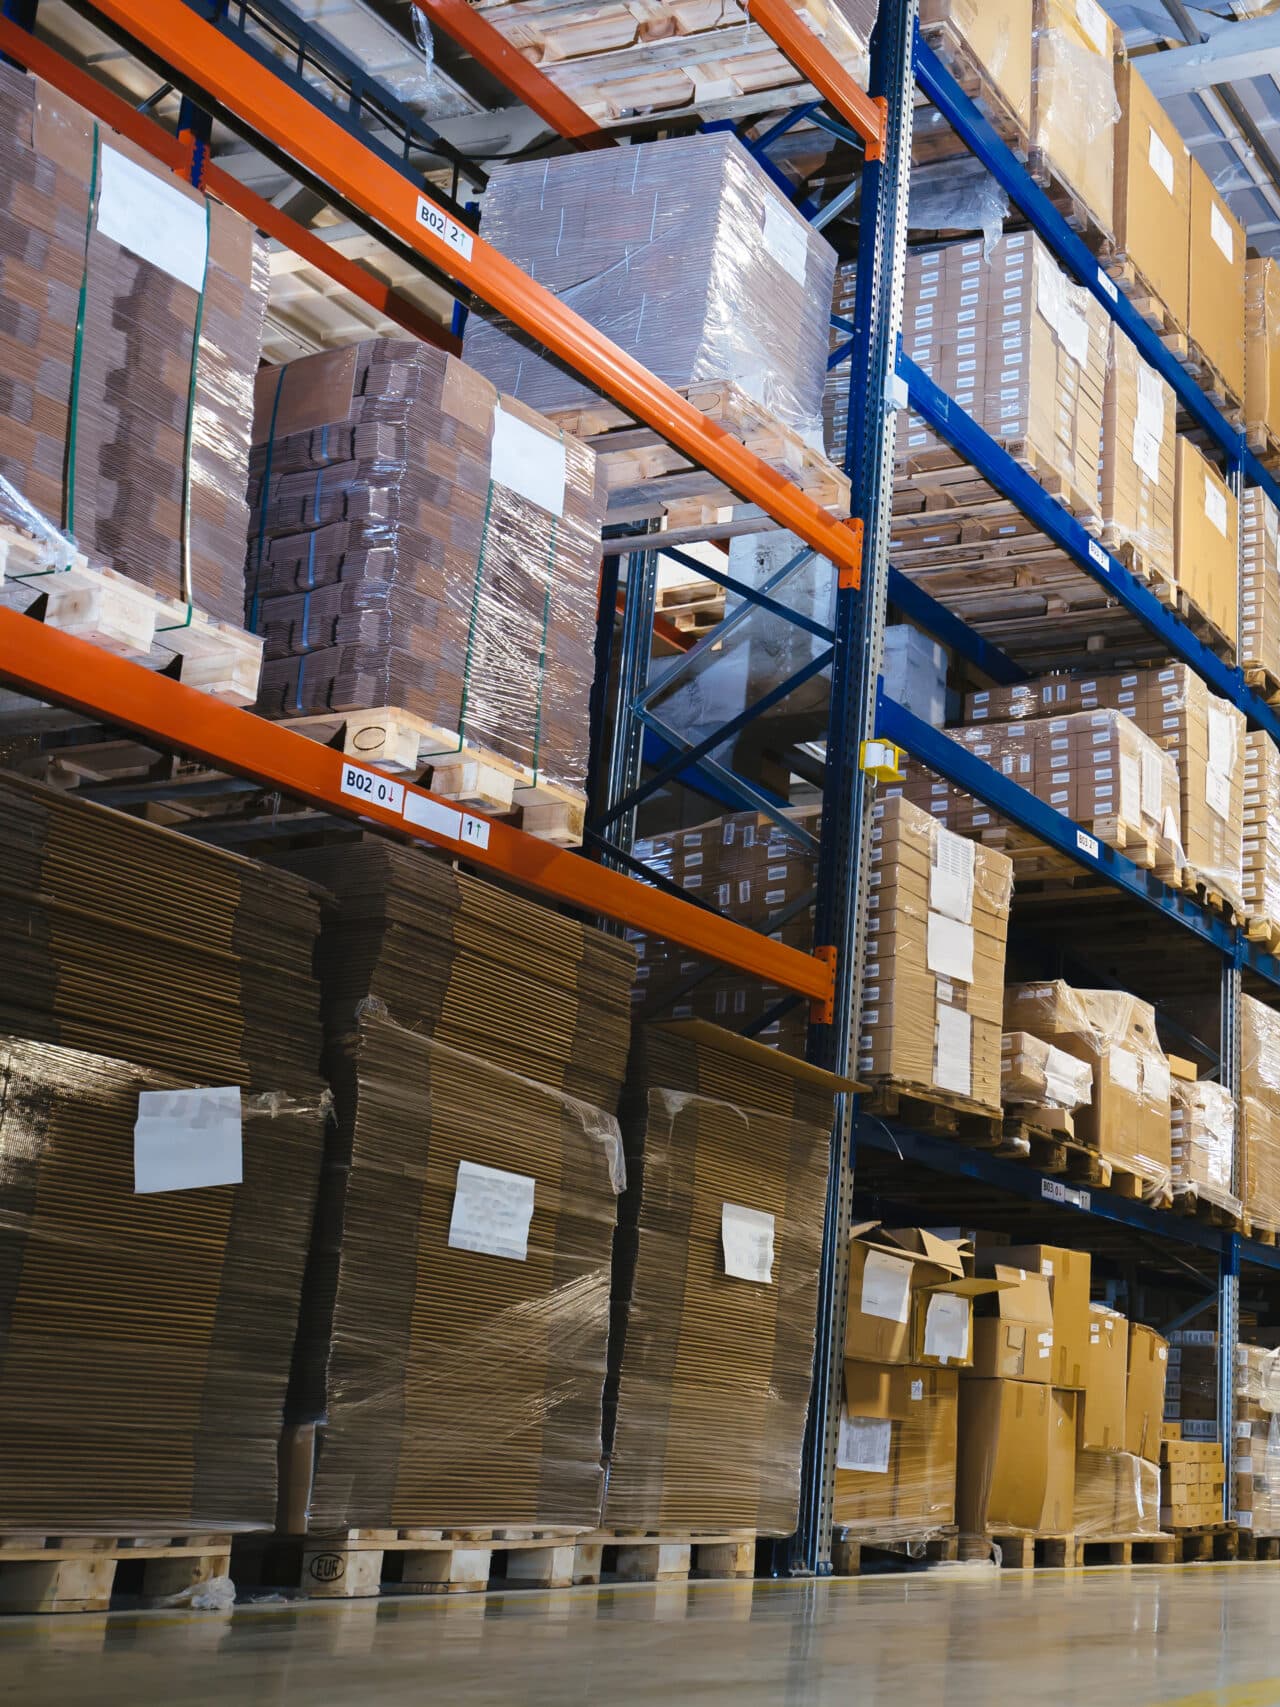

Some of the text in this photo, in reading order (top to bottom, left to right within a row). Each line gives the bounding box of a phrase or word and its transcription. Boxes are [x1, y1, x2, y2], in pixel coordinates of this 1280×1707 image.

[421, 206, 459, 242] B02 2
[346, 770, 386, 800] B02 0
[466, 821, 473, 835] 1
[1043, 1181, 1053, 1193] B03
